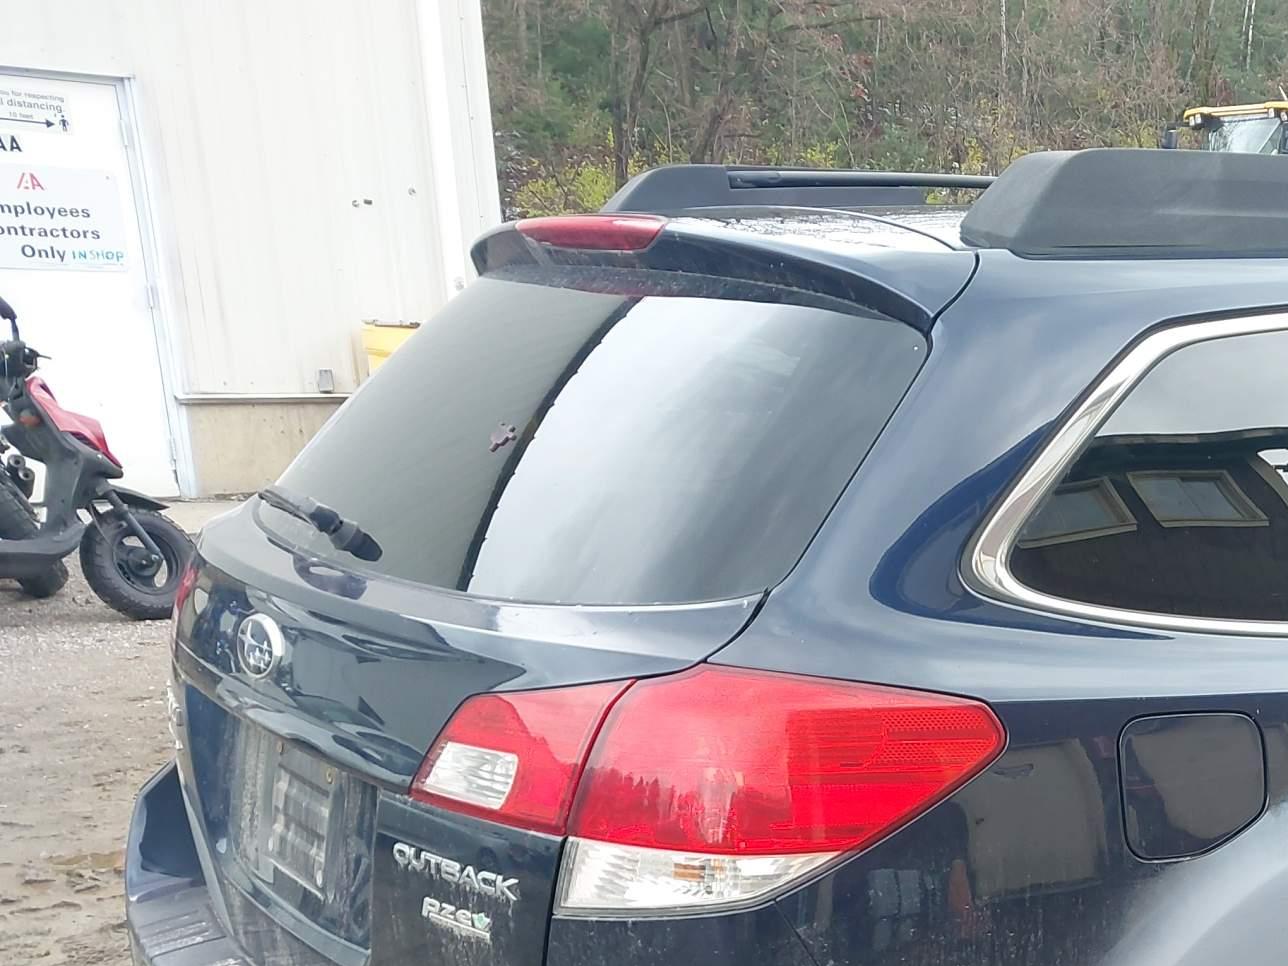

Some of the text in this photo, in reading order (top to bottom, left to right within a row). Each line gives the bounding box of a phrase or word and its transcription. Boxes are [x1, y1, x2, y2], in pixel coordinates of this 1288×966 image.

[6, 98, 63, 114] distancing
[21, 244, 66, 263] Only
[392, 841, 520, 901] OUTBACK
